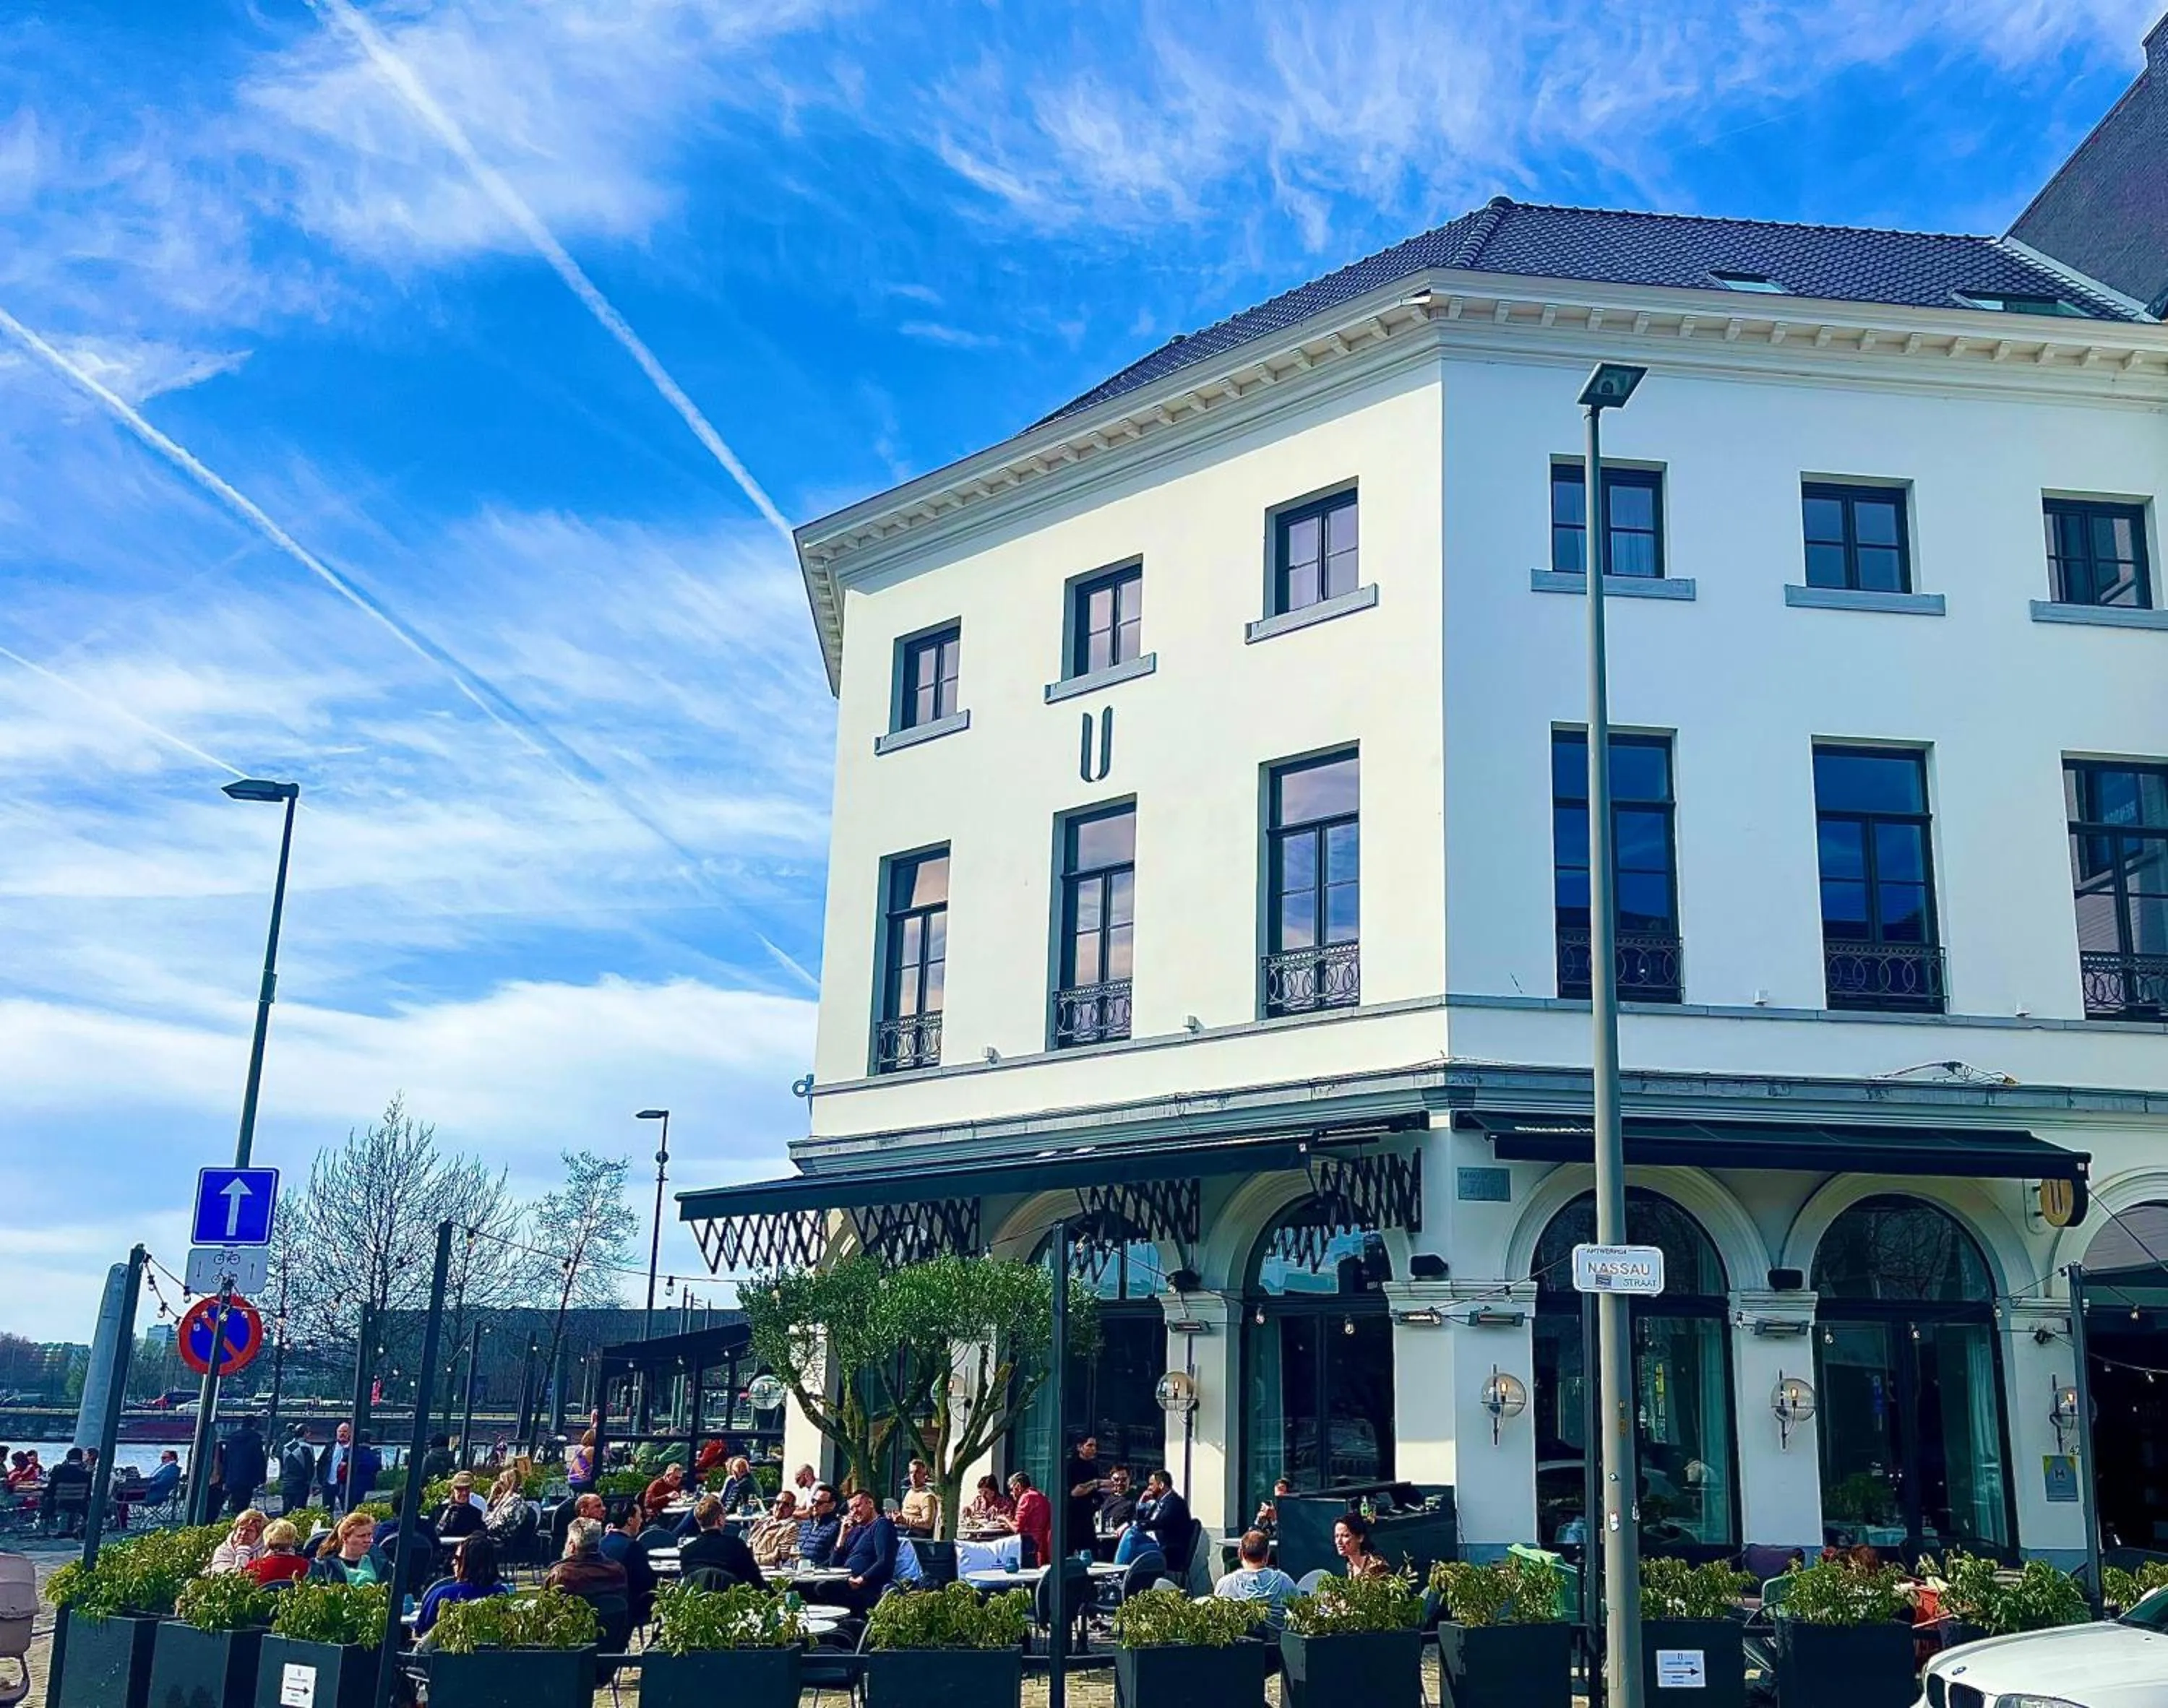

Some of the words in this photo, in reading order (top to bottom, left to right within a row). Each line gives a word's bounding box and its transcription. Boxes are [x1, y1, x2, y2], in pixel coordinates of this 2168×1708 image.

[1080, 705, 1113, 782] U
[1588, 1262, 1651, 1275] NASSAU
[1623, 1278, 1656, 1287] STRAAT
